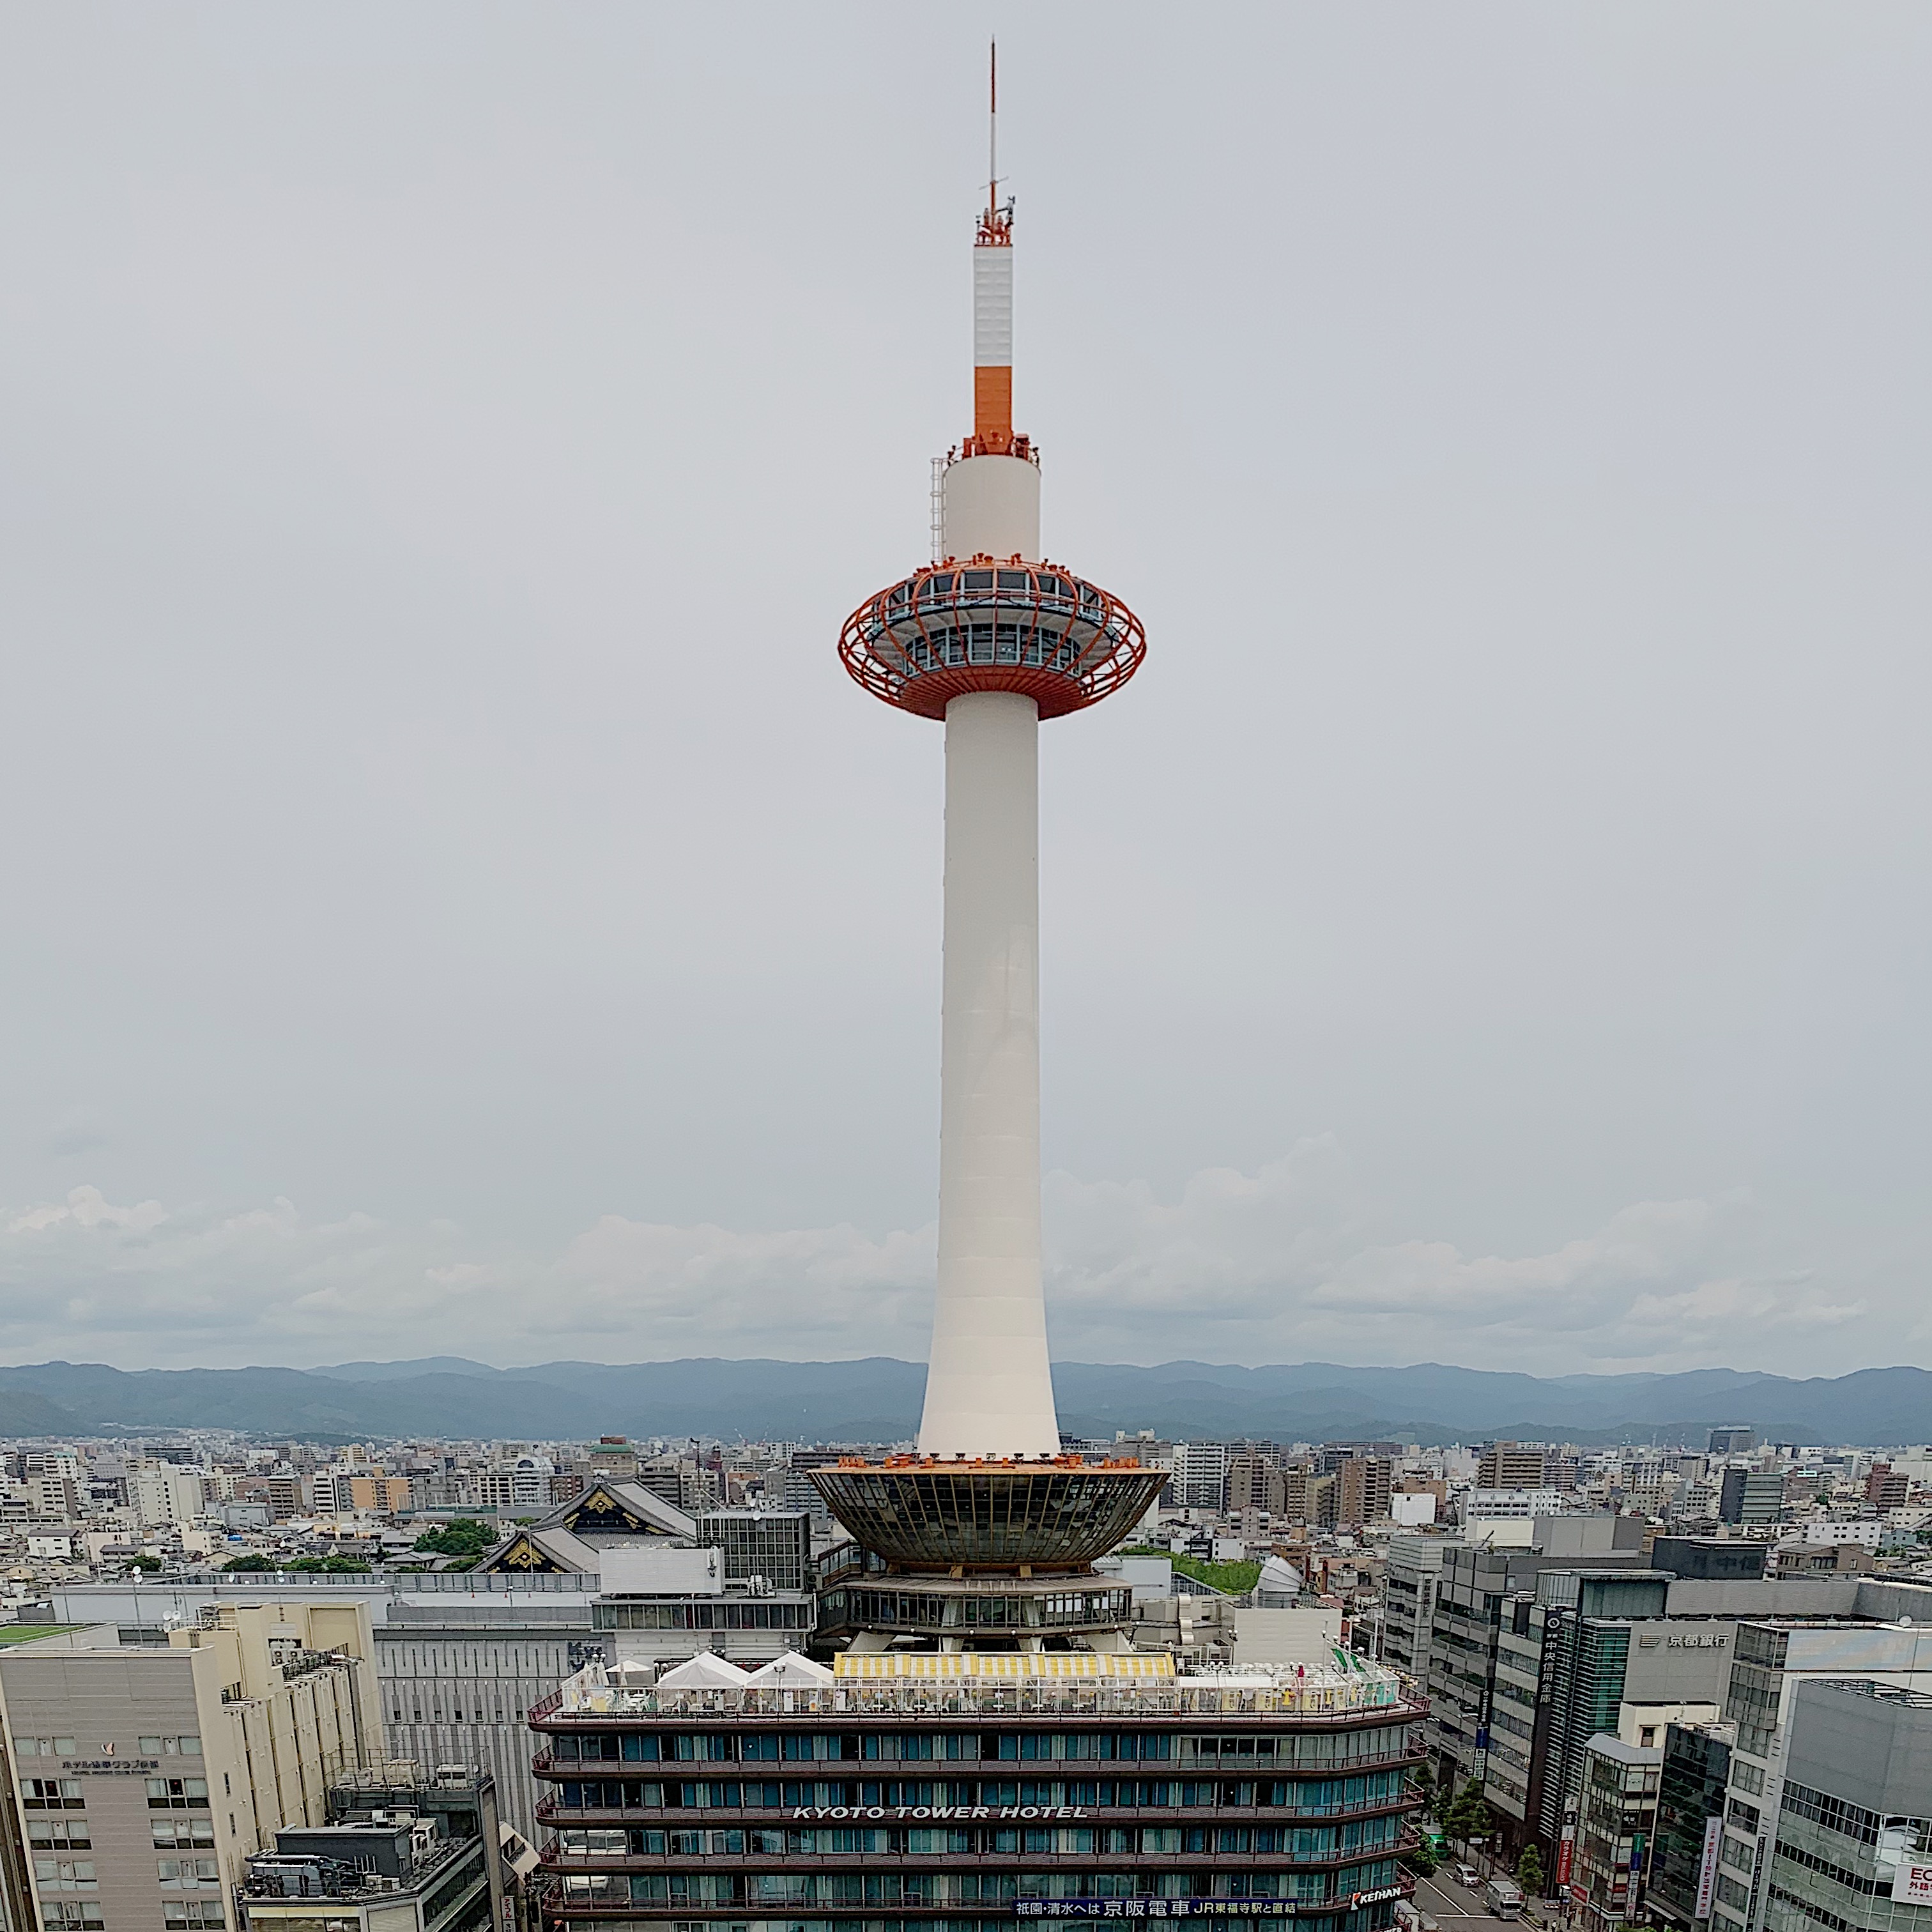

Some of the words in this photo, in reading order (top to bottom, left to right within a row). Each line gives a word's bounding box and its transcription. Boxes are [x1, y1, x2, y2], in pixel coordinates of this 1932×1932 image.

[1668, 1633, 1729, 1647] 京都銀行
[792, 1806, 887, 1818] KYOTO
[895, 1806, 990, 1818] TOWER
[1000, 1806, 1088, 1818] HOTEL
[1360, 1887, 1401, 1904] KEIHAN
[1016, 1902, 1100, 1915] 祇園・清水へは
[1103, 1900, 1190, 1917] 京阪電車
[1193, 1902, 1296, 1914] JR東福寺駅と直結
